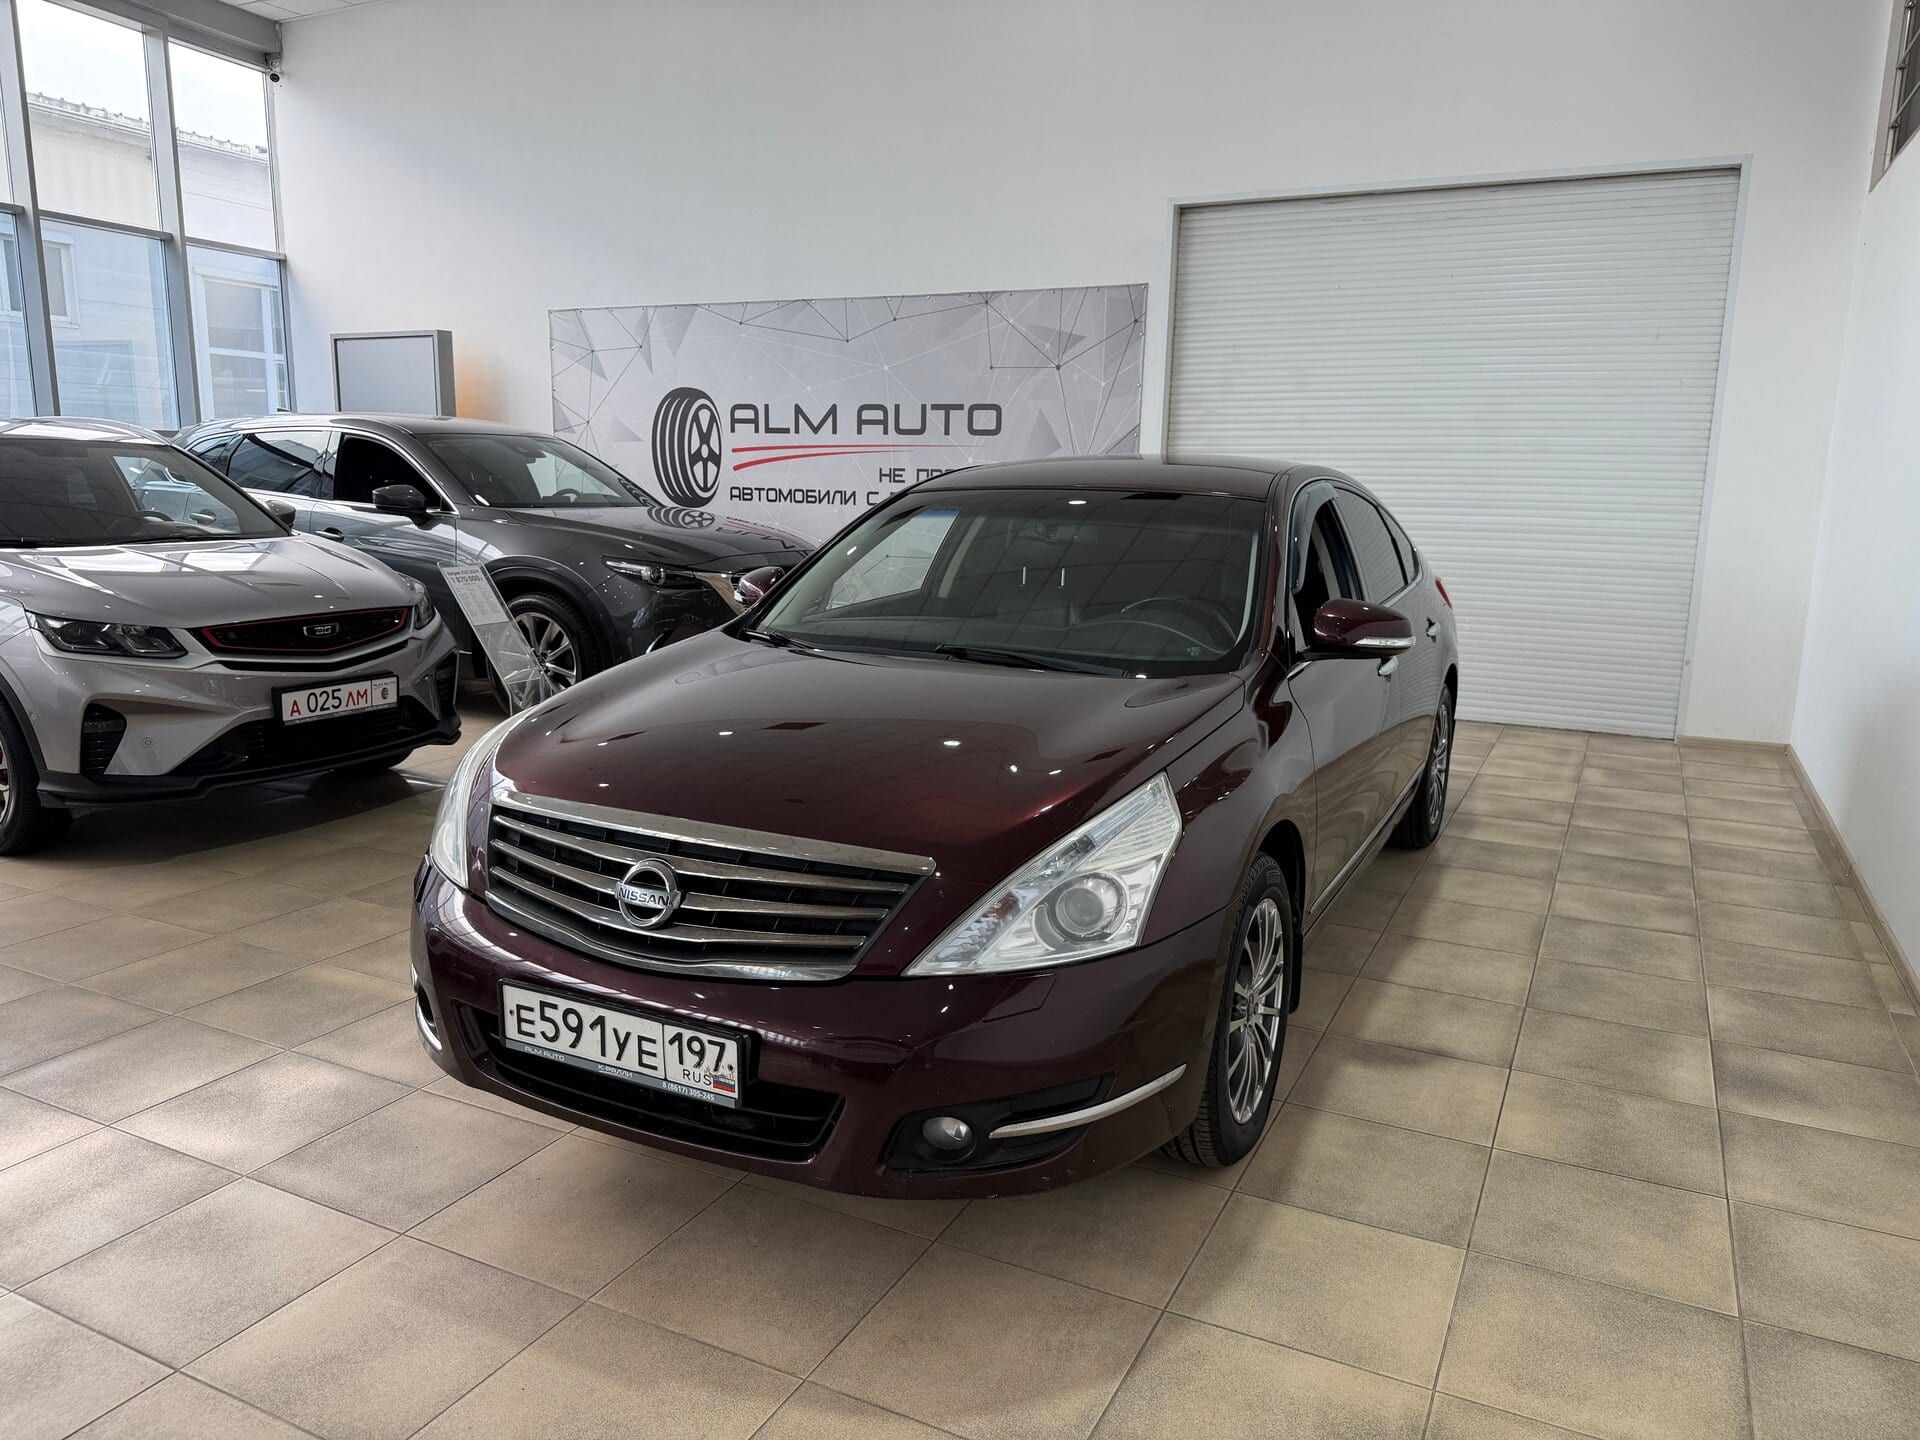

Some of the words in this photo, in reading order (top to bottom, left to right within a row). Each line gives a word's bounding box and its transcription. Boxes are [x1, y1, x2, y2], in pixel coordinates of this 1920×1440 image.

[730, 403, 837, 434] ALM
[856, 403, 1002, 436] AUTO
[879, 467, 906, 483] НЕ
[729, 486, 856, 506] АВТОМОБИЛИ
[306, 688, 342, 713] 025
[618, 887, 669, 906] NISSAN
[524, 1046, 542, 1056] ALM
[543, 1051, 565, 1061] AUTO
[668, 1031, 726, 1072] 197
[682, 1068, 712, 1086] RUS
